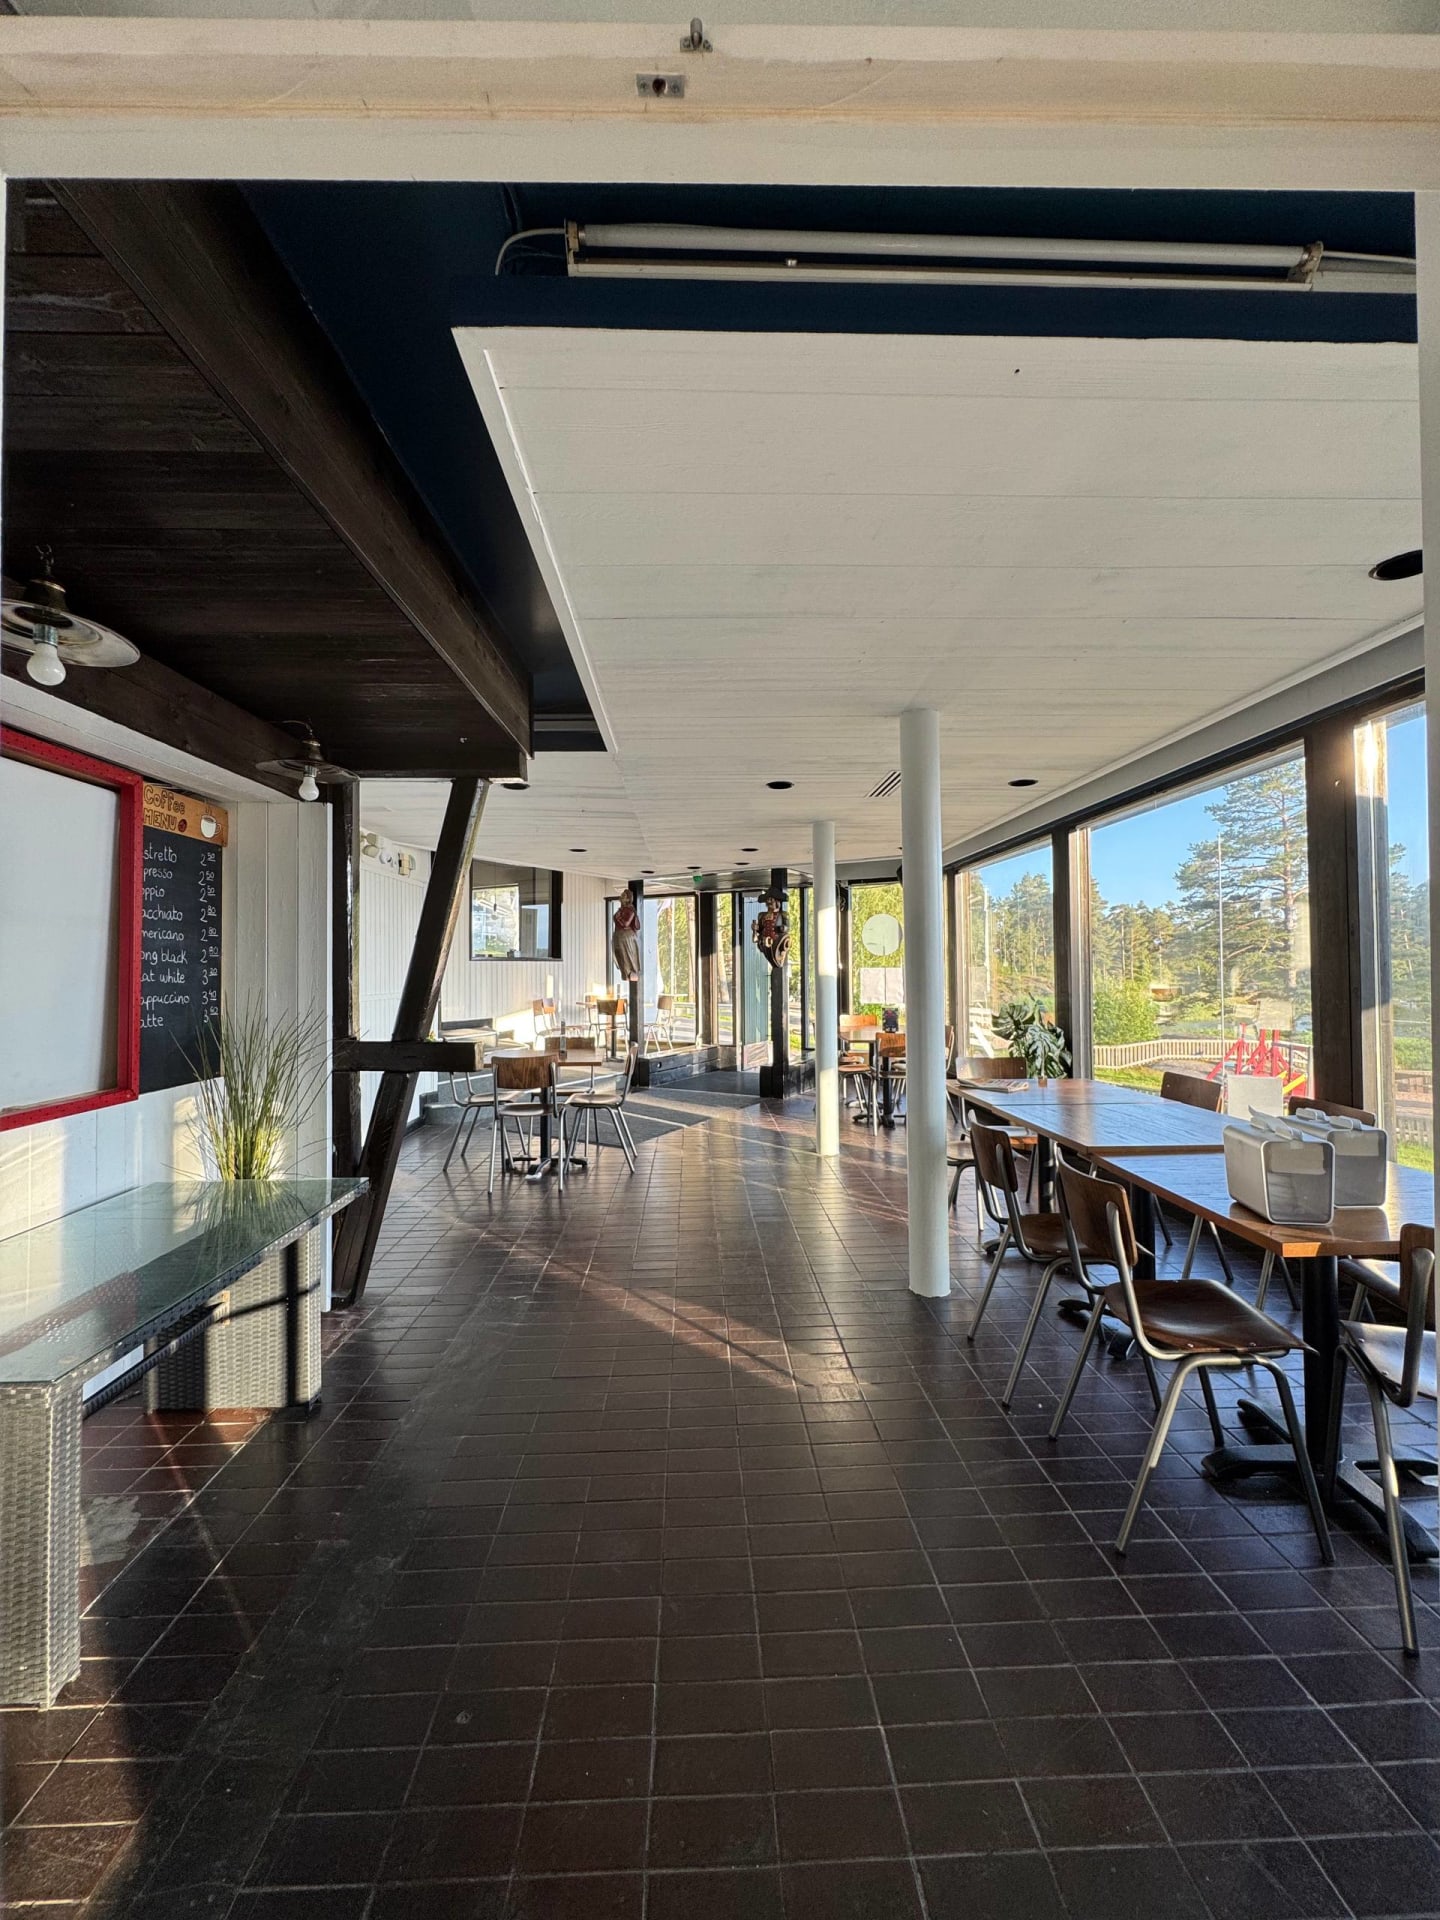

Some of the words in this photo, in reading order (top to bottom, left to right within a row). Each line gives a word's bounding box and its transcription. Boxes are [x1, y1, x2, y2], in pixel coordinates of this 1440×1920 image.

[143, 808, 177, 831] MENU
[161, 947, 188, 964] black
[160, 968, 185, 984] white
